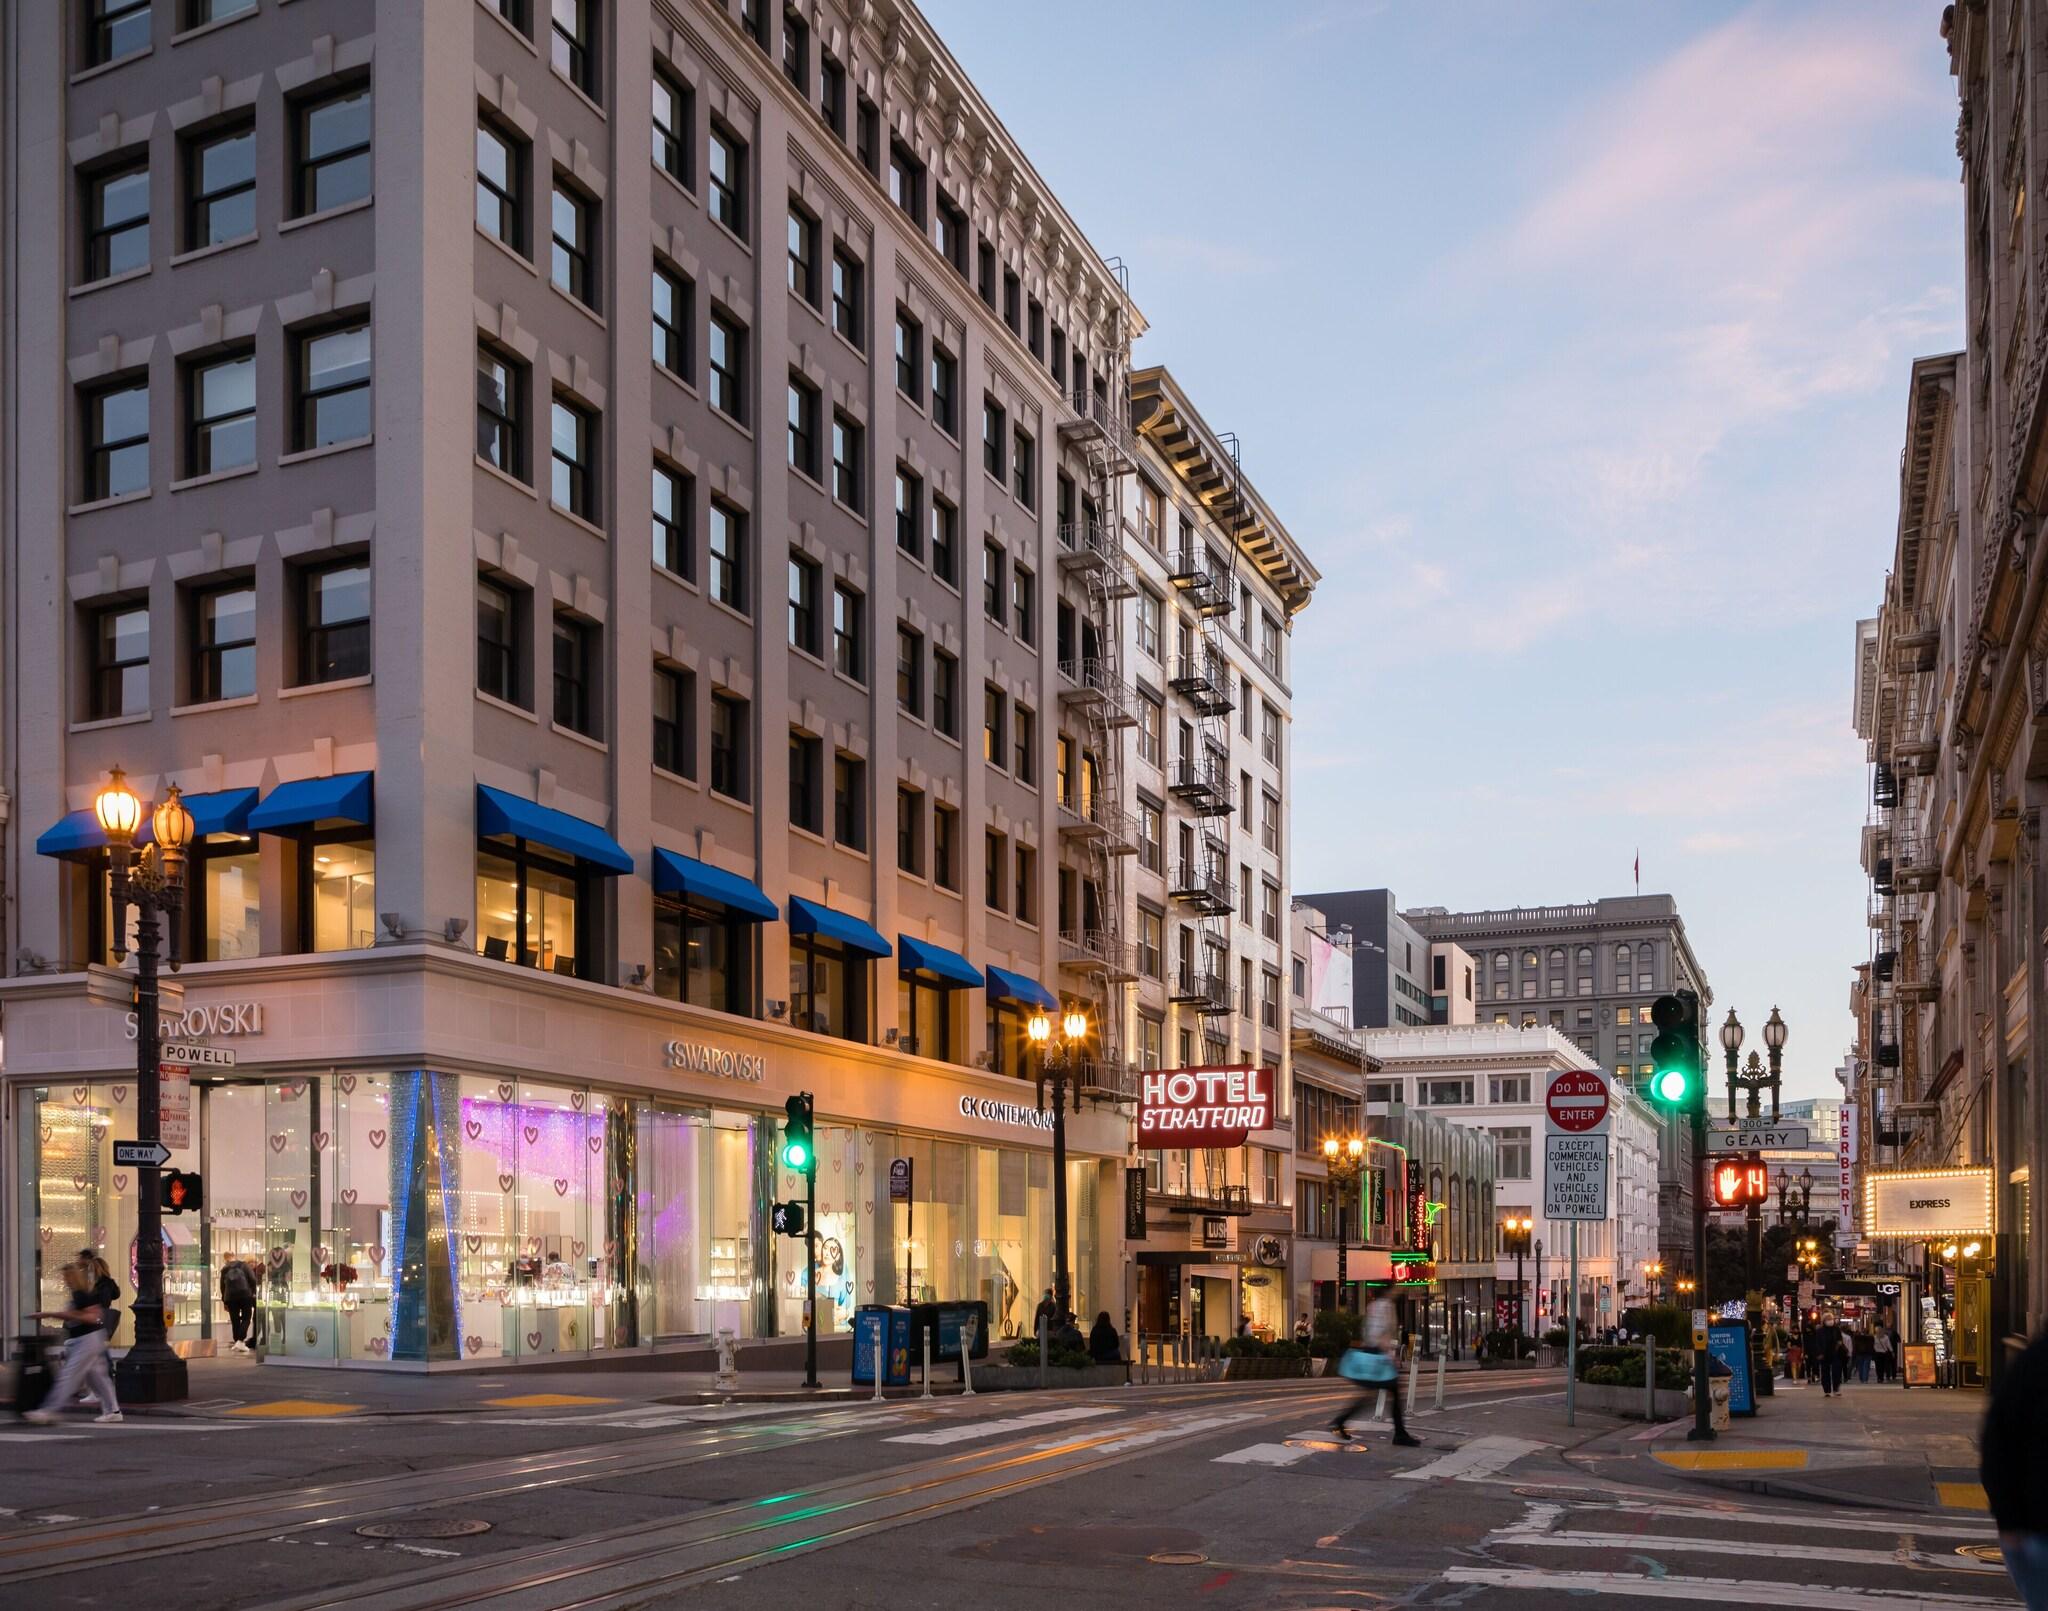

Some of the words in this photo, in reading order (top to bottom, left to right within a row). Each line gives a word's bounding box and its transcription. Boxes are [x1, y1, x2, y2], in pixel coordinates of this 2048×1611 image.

[125, 1003, 263, 1040] SAROVSKI
[166, 1046, 232, 1064] POWELL
[668, 1040, 767, 1081] SWAROVSKI
[1143, 1070, 1267, 1105] HOTEL
[1556, 1083, 1571, 1093] DO
[1578, 1082, 1600, 1093] NOT
[961, 1095, 979, 1118] CK
[1141, 1106, 1266, 1130] STRATFORD
[1559, 1110, 1595, 1120] ENTER
[1743, 1120, 1762, 1128] 300
[1558, 1140, 1595, 1151] EXCEPT
[1725, 1133, 1789, 1147] GEARY
[119, 1149, 135, 1159] ONE
[138, 1149, 154, 1159] WAY
[1549, 1151, 1604, 1161] COMMERCIAL
[1553, 1162, 1599, 1172] VEHICLES
[1841, 1110, 1849, 1216] HERBERT
[1567, 1172, 1586, 1182] AND
[1748, 1168, 1764, 1197] 14
[1553, 1183, 1599, 1193] VEHICLES
[1555, 1193, 1596, 1204] LOADING
[1909, 1198, 1951, 1209] EXPRESS
[1547, 1203, 1560, 1214] ON
[1565, 1203, 1603, 1215] POWELL
[1877, 1284, 1900, 1295] UGG
